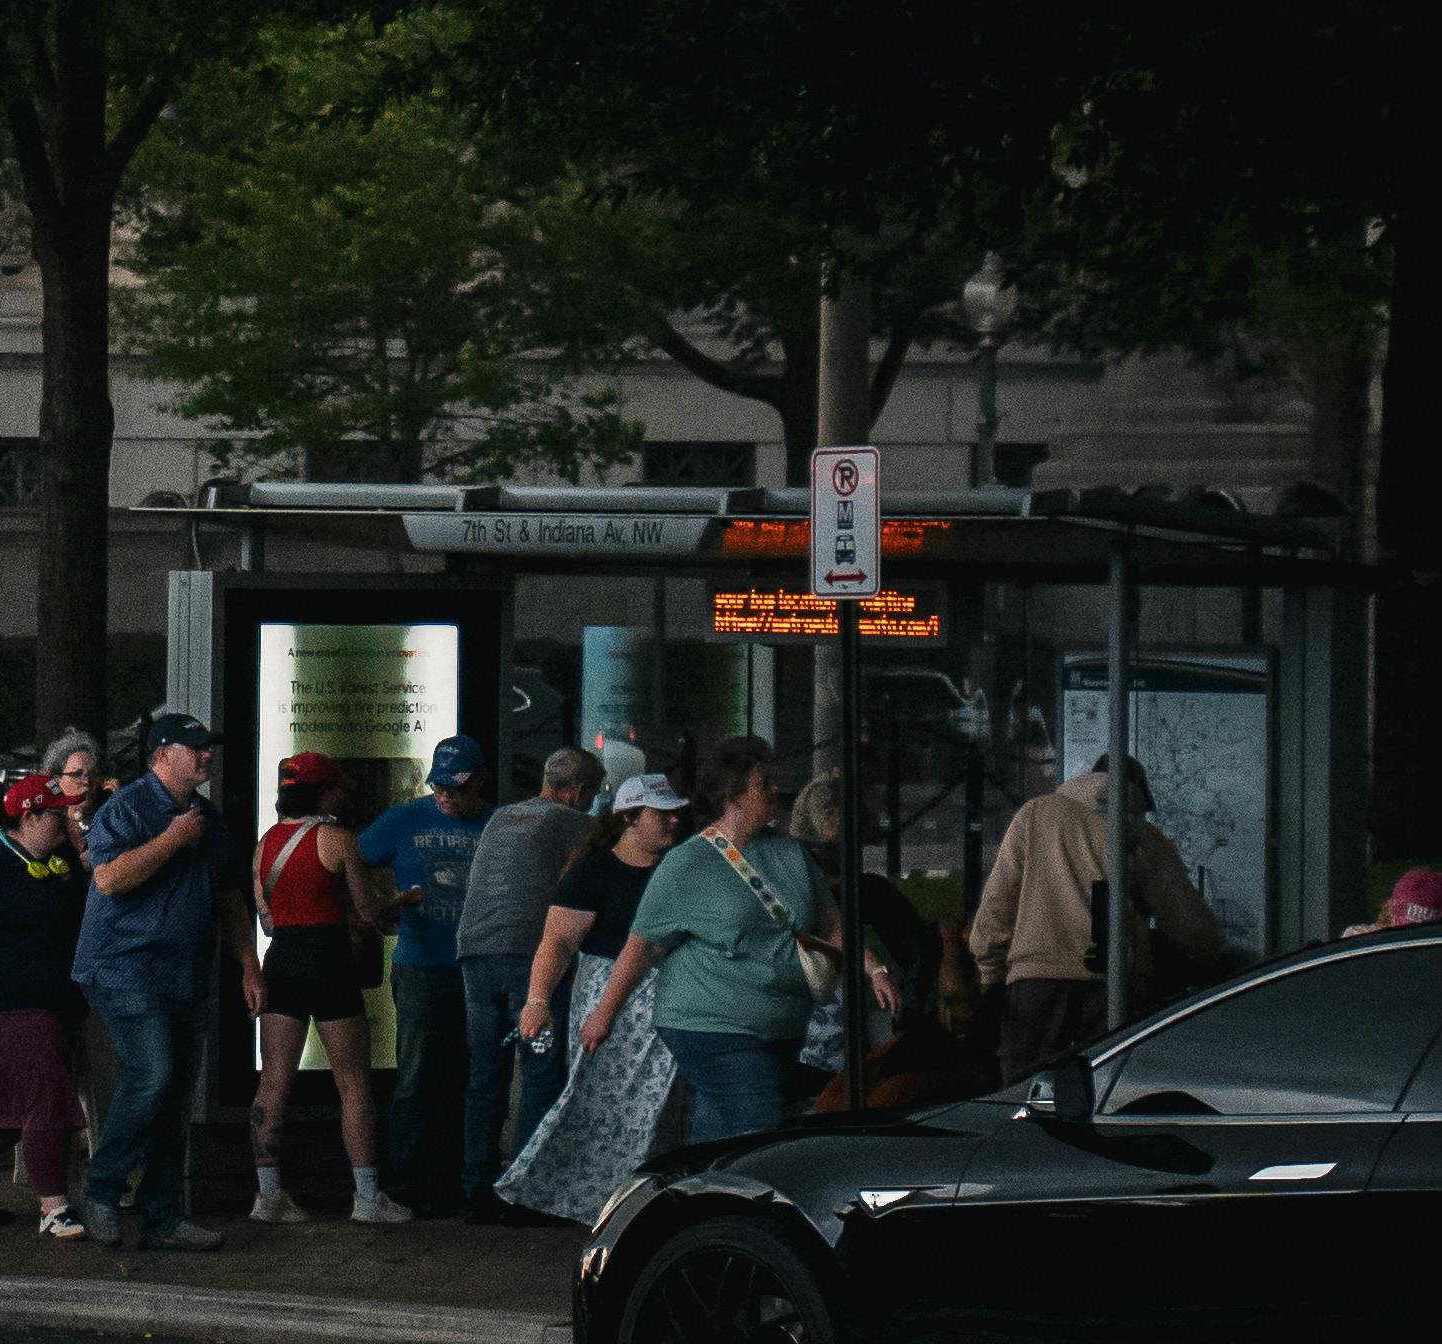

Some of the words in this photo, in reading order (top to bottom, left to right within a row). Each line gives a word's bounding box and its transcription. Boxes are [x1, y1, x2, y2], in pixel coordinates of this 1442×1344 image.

[462, 520, 487, 543] 7th
[494, 520, 512, 543] St
[519, 521, 530, 543] &
[539, 520, 595, 544] Indiana
[632, 521, 664, 544] NW
[290, 681, 313, 694] The
[340, 681, 379, 694] Forest
[382, 681, 426, 694] Service
[277, 703, 287, 714] is
[290, 702, 350, 716] improving
[376, 701, 437, 716] prediction
[289, 721, 333, 733] models
[336, 720, 363, 733] with
[364, 720, 410, 736] Google
